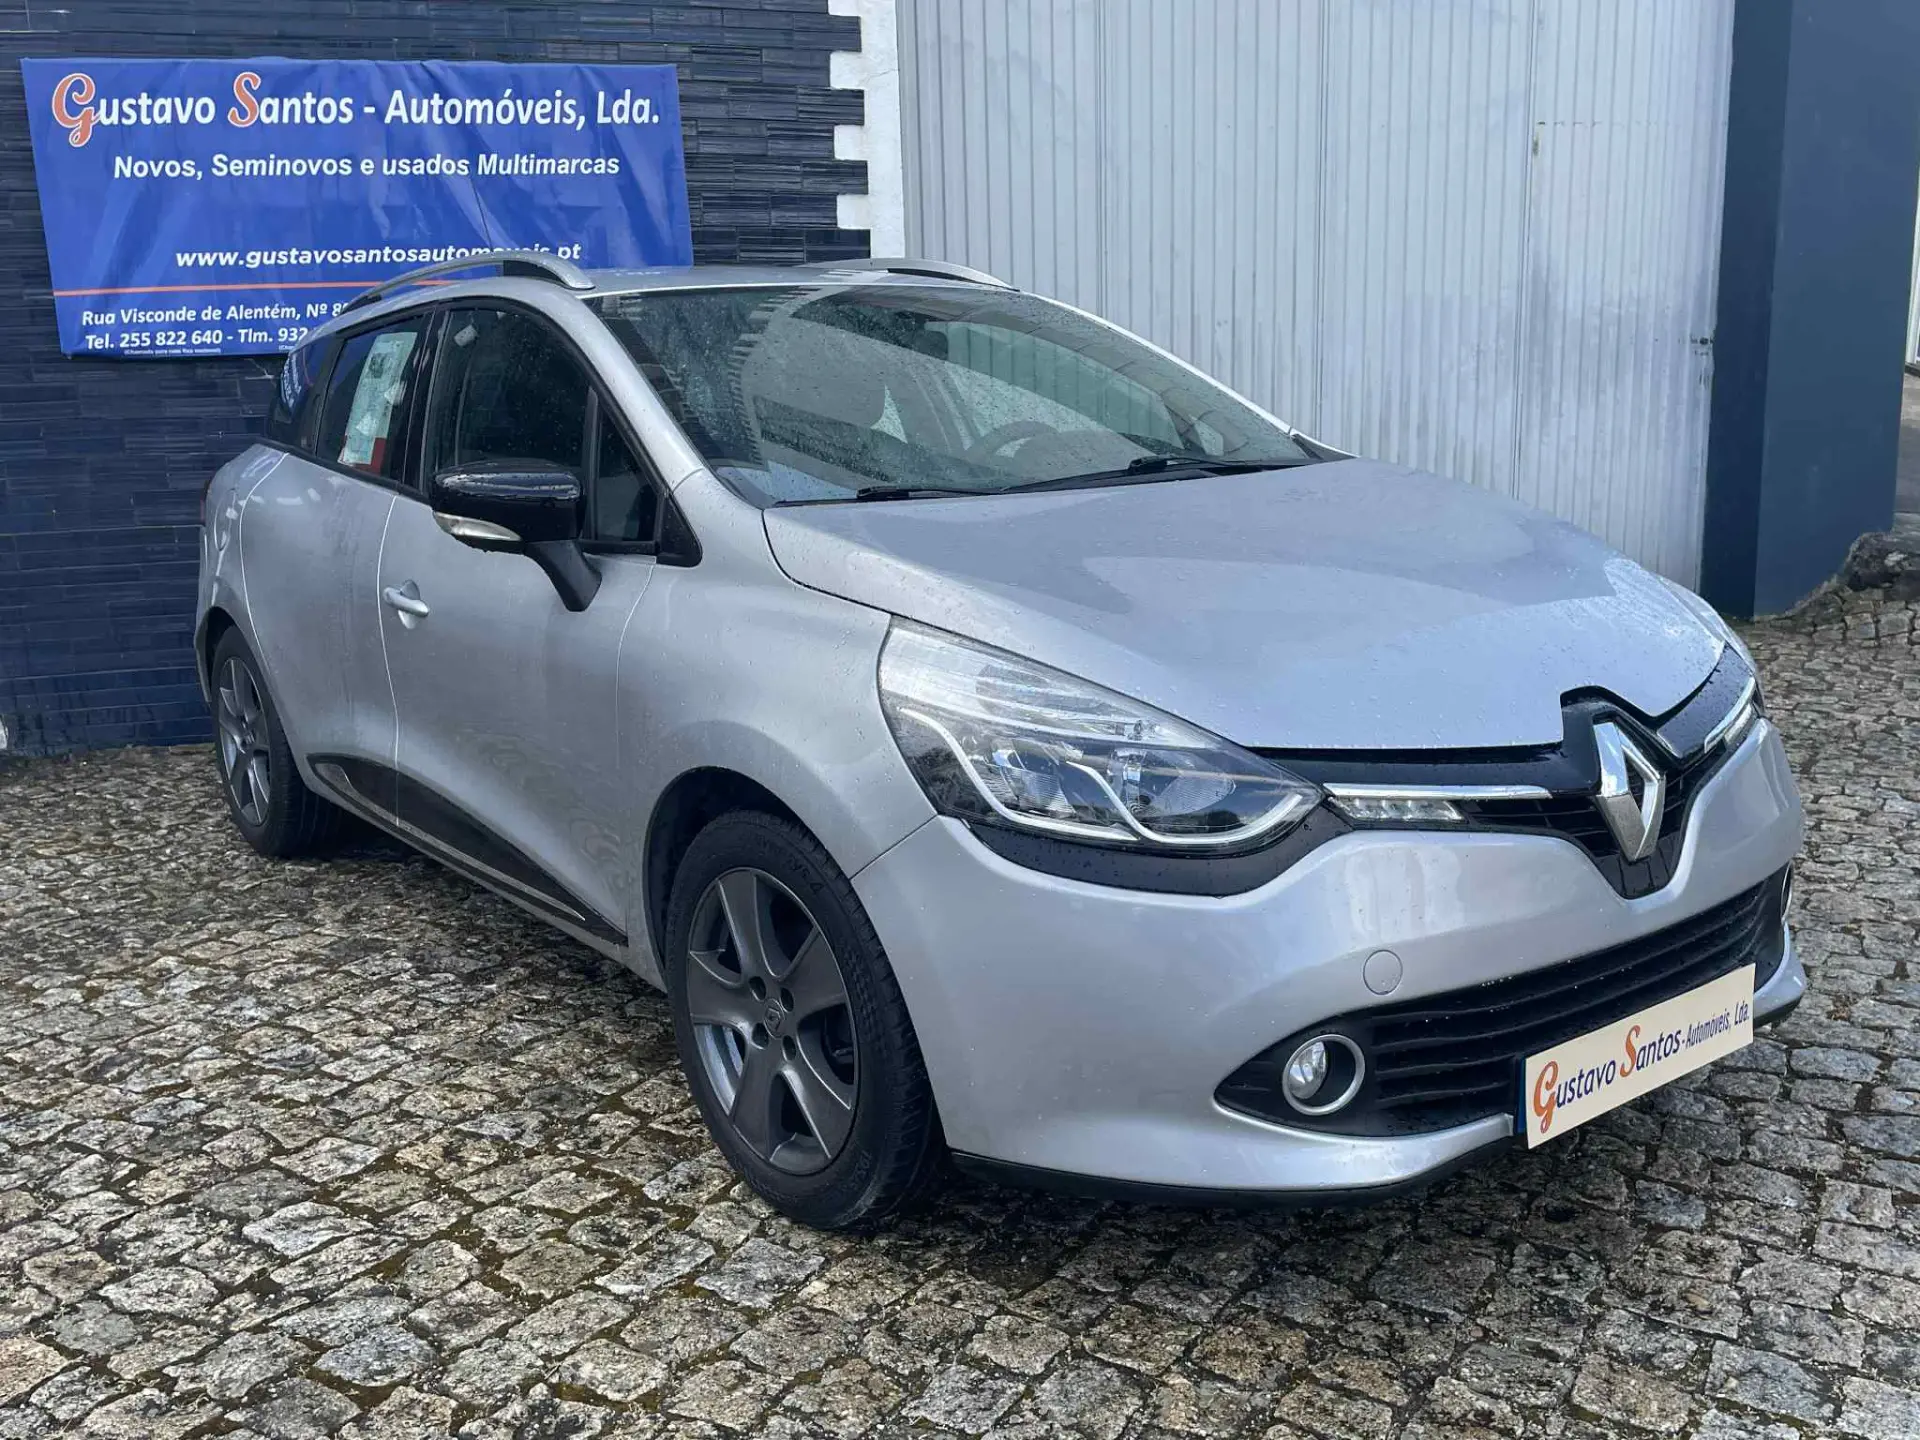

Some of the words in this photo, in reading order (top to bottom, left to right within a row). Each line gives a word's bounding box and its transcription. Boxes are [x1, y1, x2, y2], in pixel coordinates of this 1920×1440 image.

[52, 72, 216, 148] Gustavo
[227, 71, 353, 128] Santos
[384, 88, 586, 131] Automóveis,
[596, 88, 660, 125] Lda.
[113, 155, 203, 181] Novos,
[211, 153, 353, 177] Seminovos
[360, 158, 375, 175] e
[382, 153, 470, 176] usados
[477, 153, 620, 176] Multimarcas
[82, 310, 116, 326] Rua
[120, 306, 196, 324] Visconde
[200, 305, 222, 321] de
[226, 303, 301, 321] Alentém,
[306, 303, 328, 318] Nº
[331, 302, 349, 317] 8
[85, 333, 115, 350] Tel.
[119, 332, 151, 348] 255
[155, 330, 187, 346] 822
[191, 329, 223, 345] 640
[237, 327, 274, 344] Tlm.
[1533, 1060, 1616, 1134] Gustavo
[1734, 1000, 1750, 1026] Lda.
